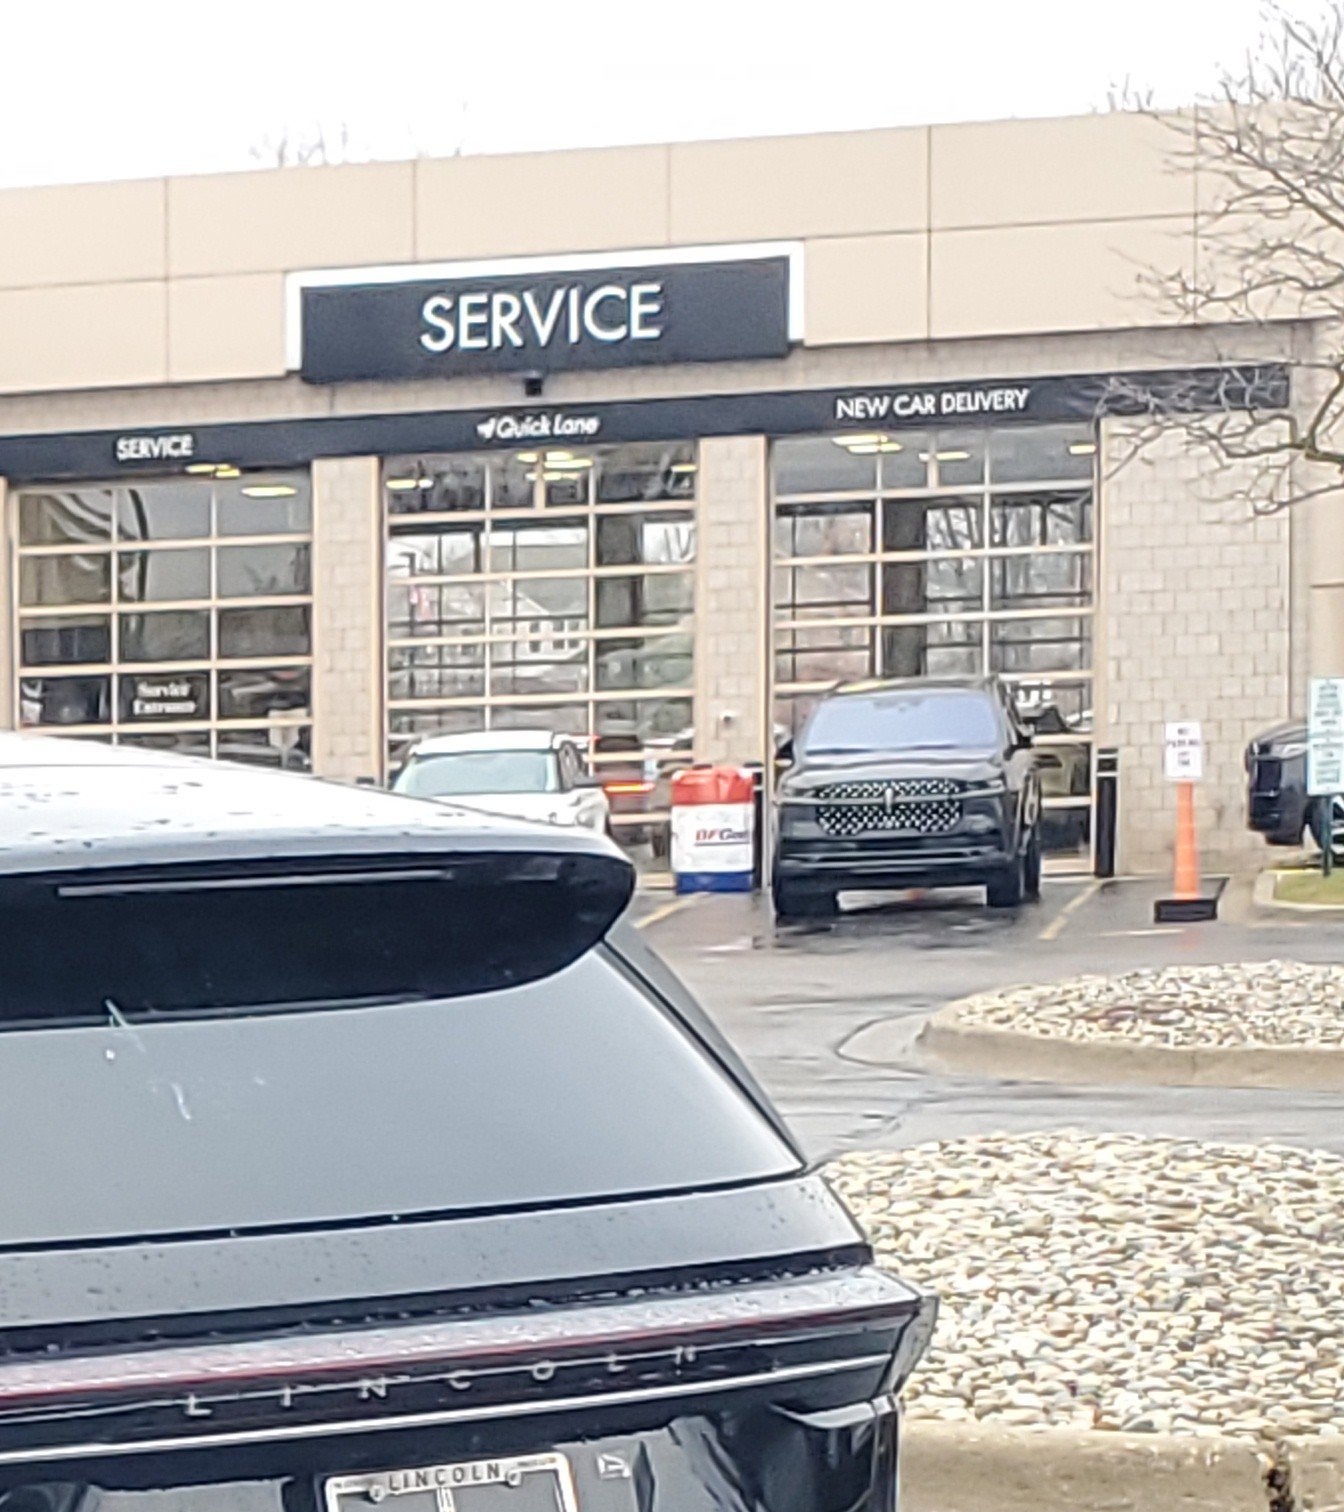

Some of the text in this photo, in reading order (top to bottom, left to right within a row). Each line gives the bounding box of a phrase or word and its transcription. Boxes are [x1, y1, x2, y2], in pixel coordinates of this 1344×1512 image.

[420, 283, 663, 353] SERVICE
[836, 388, 1030, 419] NEW CAR DELIVERY
[497, 413, 600, 439] Quick Lane
[116, 433, 193, 461] SERVICE
[184, 1346, 697, 1416] LINCOLN
[388, 1462, 501, 1491] LINCOLN
